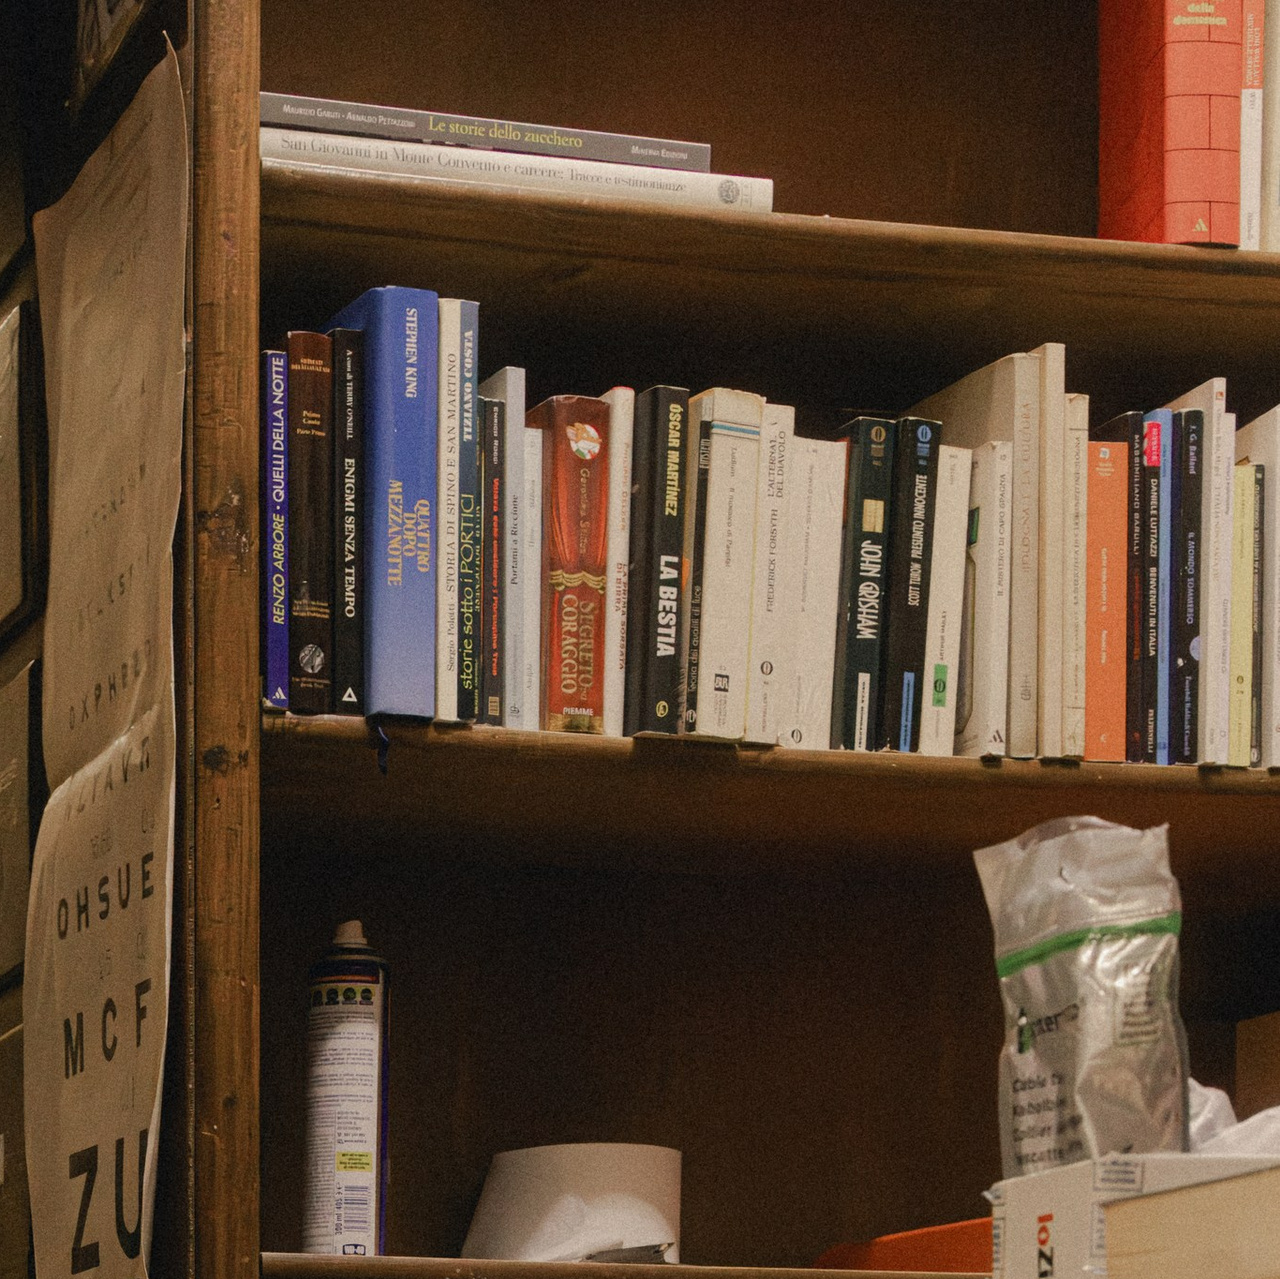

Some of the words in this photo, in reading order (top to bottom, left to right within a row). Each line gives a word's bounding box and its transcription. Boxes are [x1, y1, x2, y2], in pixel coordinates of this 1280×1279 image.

[429, 116, 446, 132] Le
[449, 121, 485, 137] storie
[489, 124, 521, 141] dello
[524, 130, 583, 148] zucchero
[281, 137, 307, 151] San
[311, 139, 372, 154] Giovanni
[375, 146, 388, 160] in
[392, 147, 434, 164] Monte
[437, 153, 501, 171] Convento
[504, 163, 512, 173] e
[569, 167, 603, 183] Tracce
[605, 175, 613, 184] e
[405, 307, 417, 363] STEPHEN
[463, 330, 473, 378] COSTA
[272, 357, 284, 404] NOTTE
[405, 366, 417, 398] KING
[447, 352, 457, 420] MARTINO
[272, 406, 284, 452] DELLA
[463, 382, 473, 442] TIZIANO
[668, 403, 684, 447] ÓSCAR
[447, 425, 456, 454] SAN
[776, 430, 786, 476] DIAVOLO
[1188, 445, 1197, 475] Ballard
[272, 453, 285, 503] QUELLI
[345, 458, 355, 512] ENIGMI
[446, 458, 456, 468] E
[665, 450, 680, 517] MARTÍNEZ
[446, 472, 456, 516] SPINO
[776, 479, 784, 499] DEL
[913, 474, 928, 520] INNOCENTE
[1150, 478, 1158, 516] DANIELE
[388, 480, 403, 586] MEZZANOTTE
[404, 512, 416, 556] DOPO
[414, 498, 430, 572] QUATTRO
[446, 520, 456, 536] DI
[461, 493, 474, 573] PORTICI
[510, 494, 518, 536] Riccione
[768, 509, 778, 555] FORSYTH
[1150, 517, 1158, 557] LUTTAZZI
[273, 513, 285, 572] ARBORE
[345, 515, 355, 563] SENZA
[859, 540, 882, 578] JOHN
[911, 520, 925, 559] PRESUNTO
[998, 536, 1005, 546] DI
[1187, 540, 1195, 575] MONDO
[446, 541, 456, 593] STORIA
[510, 548, 518, 585] Portami
[616, 563, 622, 574] DI
[658, 555, 679, 580] LA
[766, 559, 776, 613] FREDERICK
[909, 562, 922, 585] TUROW
[273, 574, 285, 625] RENZO
[345, 564, 356, 618] TEMPO
[461, 587, 474, 635] sotto
[856, 581, 880, 639] GRISHAM
[908, 586, 920, 607] SCOTT
[1149, 566, 1157, 616] BENVENUTI
[1186, 577, 1195, 625] SOMMERSO
[561, 594, 579, 694] CORAGGIO
[656, 585, 678, 657] BESTIA
[1149, 617, 1156, 628] IN
[446, 640, 456, 671] Sergio
[460, 638, 474, 690] storie
[579, 601, 596, 688] SEGRETO
[563, 706, 594, 716] PIEMME
[57, 851, 155, 940] OHSUE
[63, 977, 152, 1079] MCF
[69, 1127, 149, 1275] ZU
